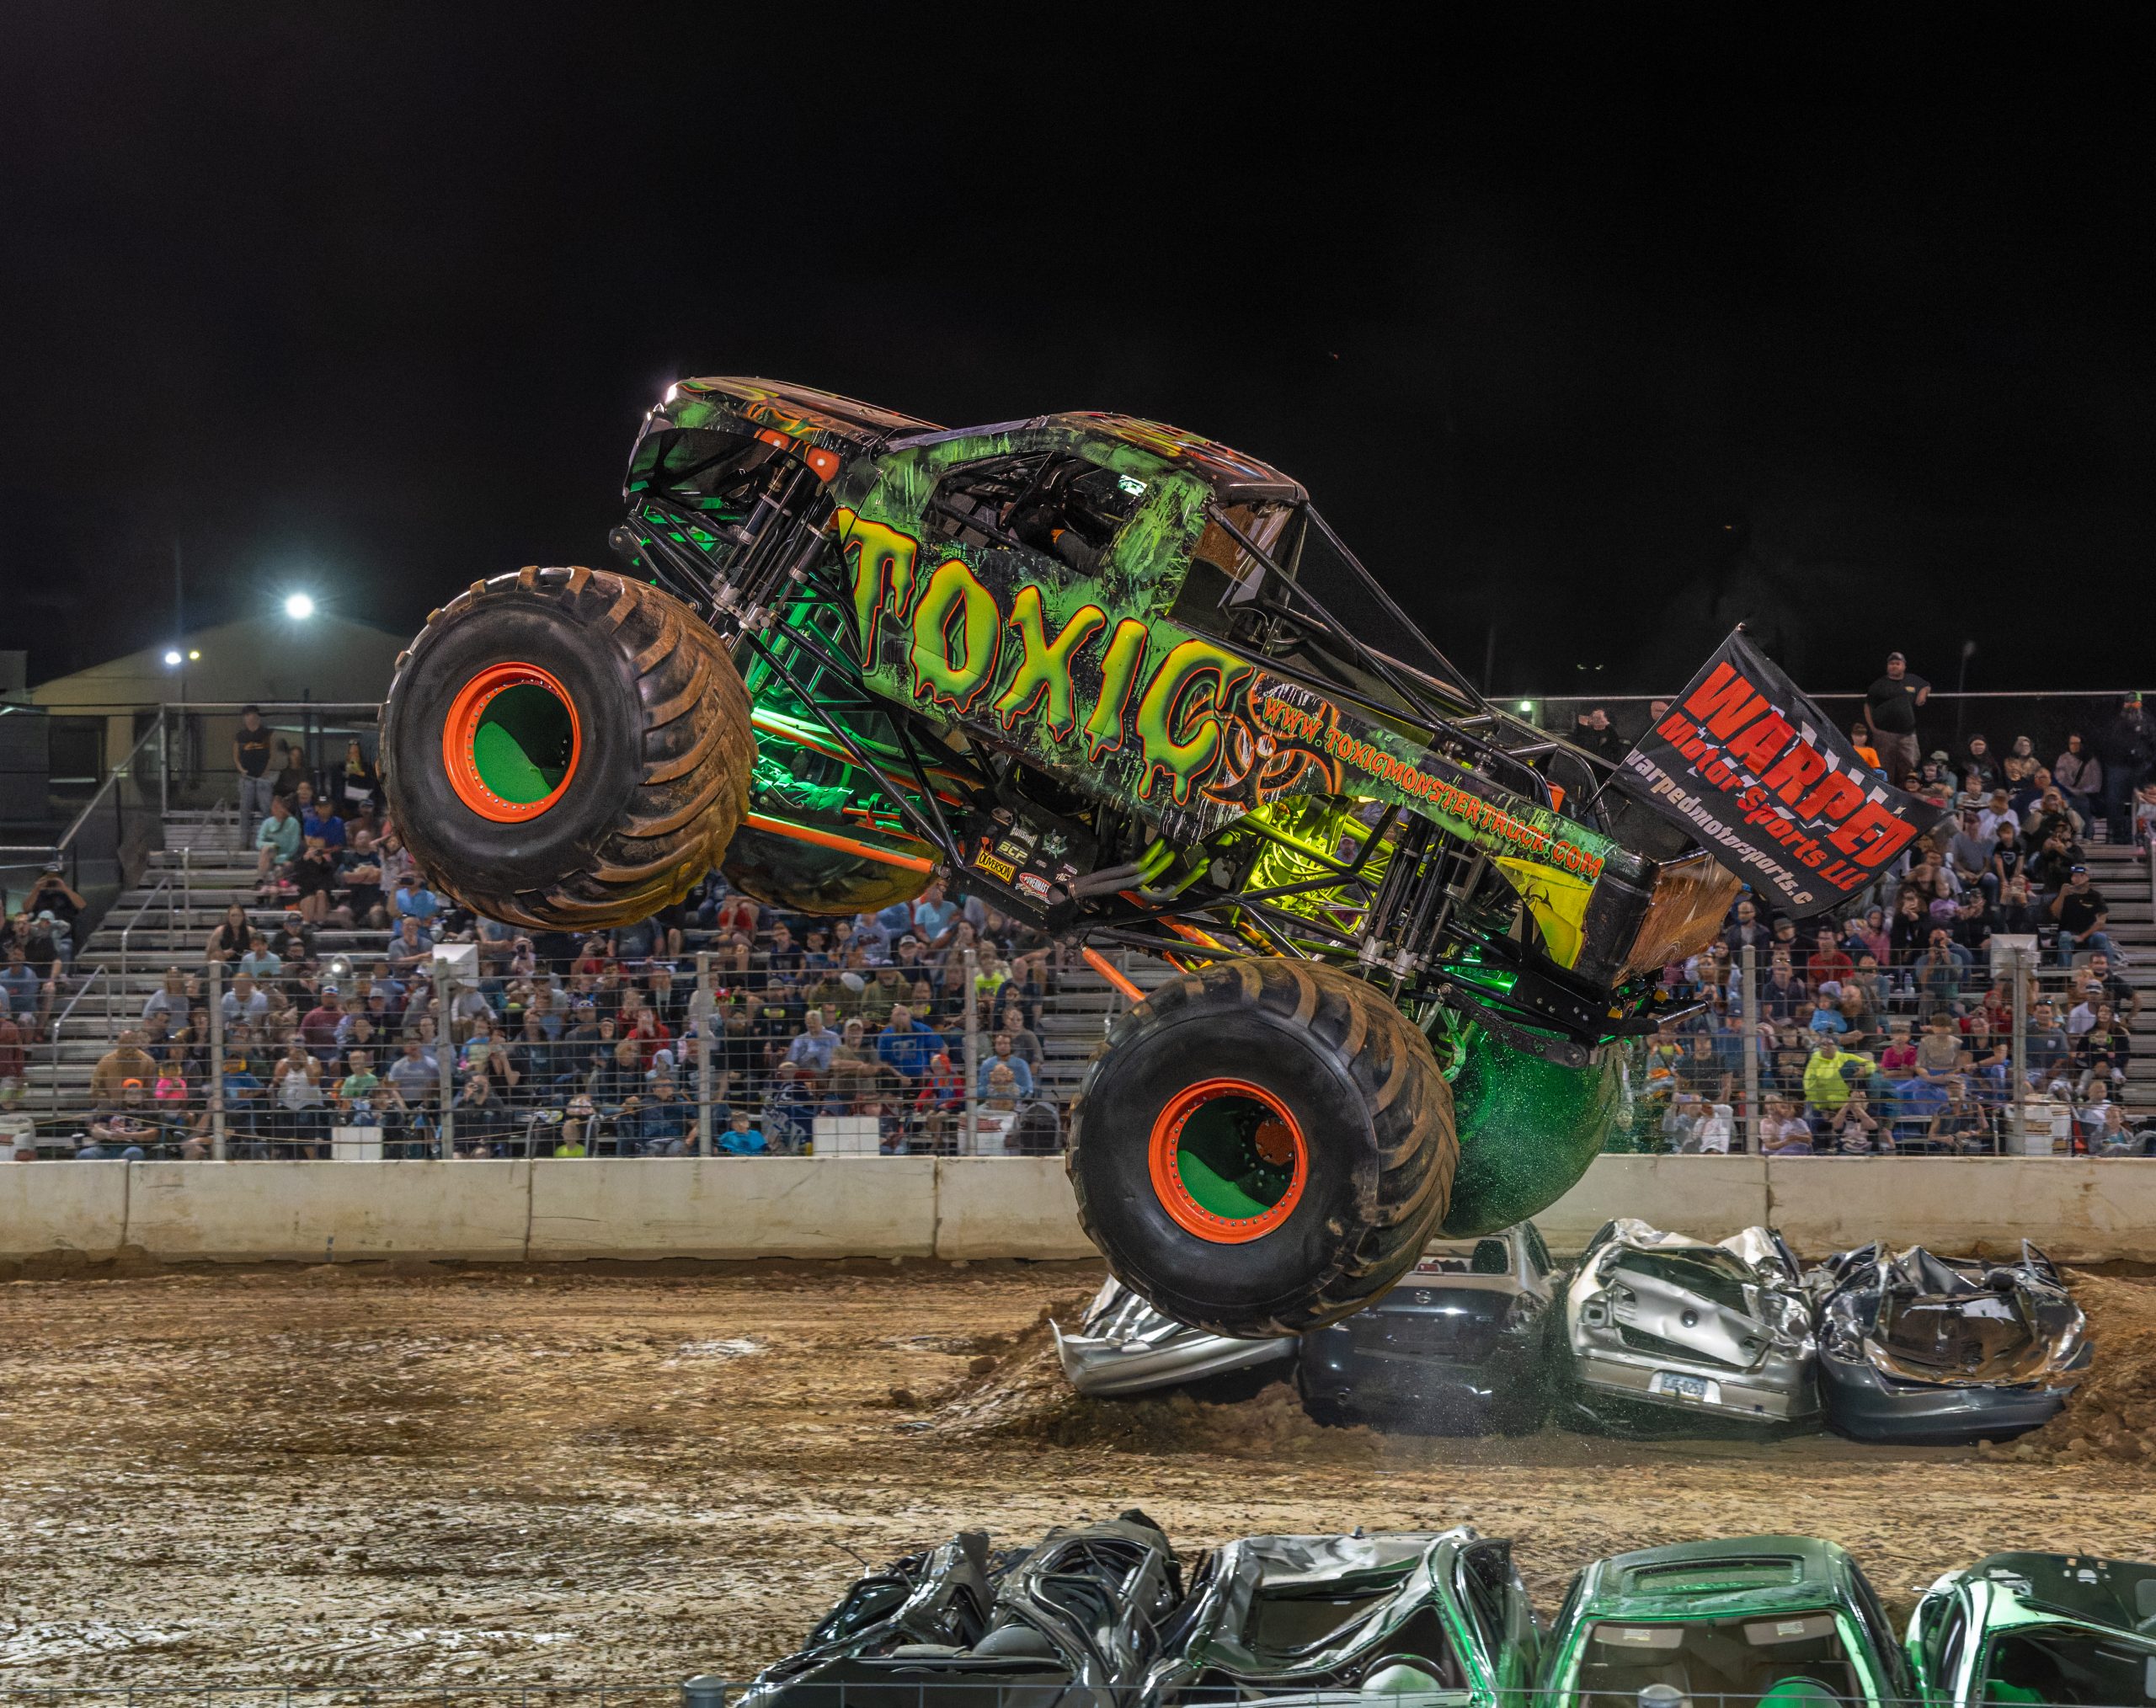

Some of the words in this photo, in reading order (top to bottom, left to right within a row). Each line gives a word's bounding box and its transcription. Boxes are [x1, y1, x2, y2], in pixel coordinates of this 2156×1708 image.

[838, 506, 1255, 806] TOXIC
[997, 841, 1028, 861] BCP
[1263, 697, 1605, 879] WWW.TOXICMONSTERTRUCK.COM
[1656, 711, 1745, 793] Motor
[1737, 786, 1828, 868] Sports
[1817, 858, 1870, 891] LLC
[1683, 660, 1918, 867] WARPED
